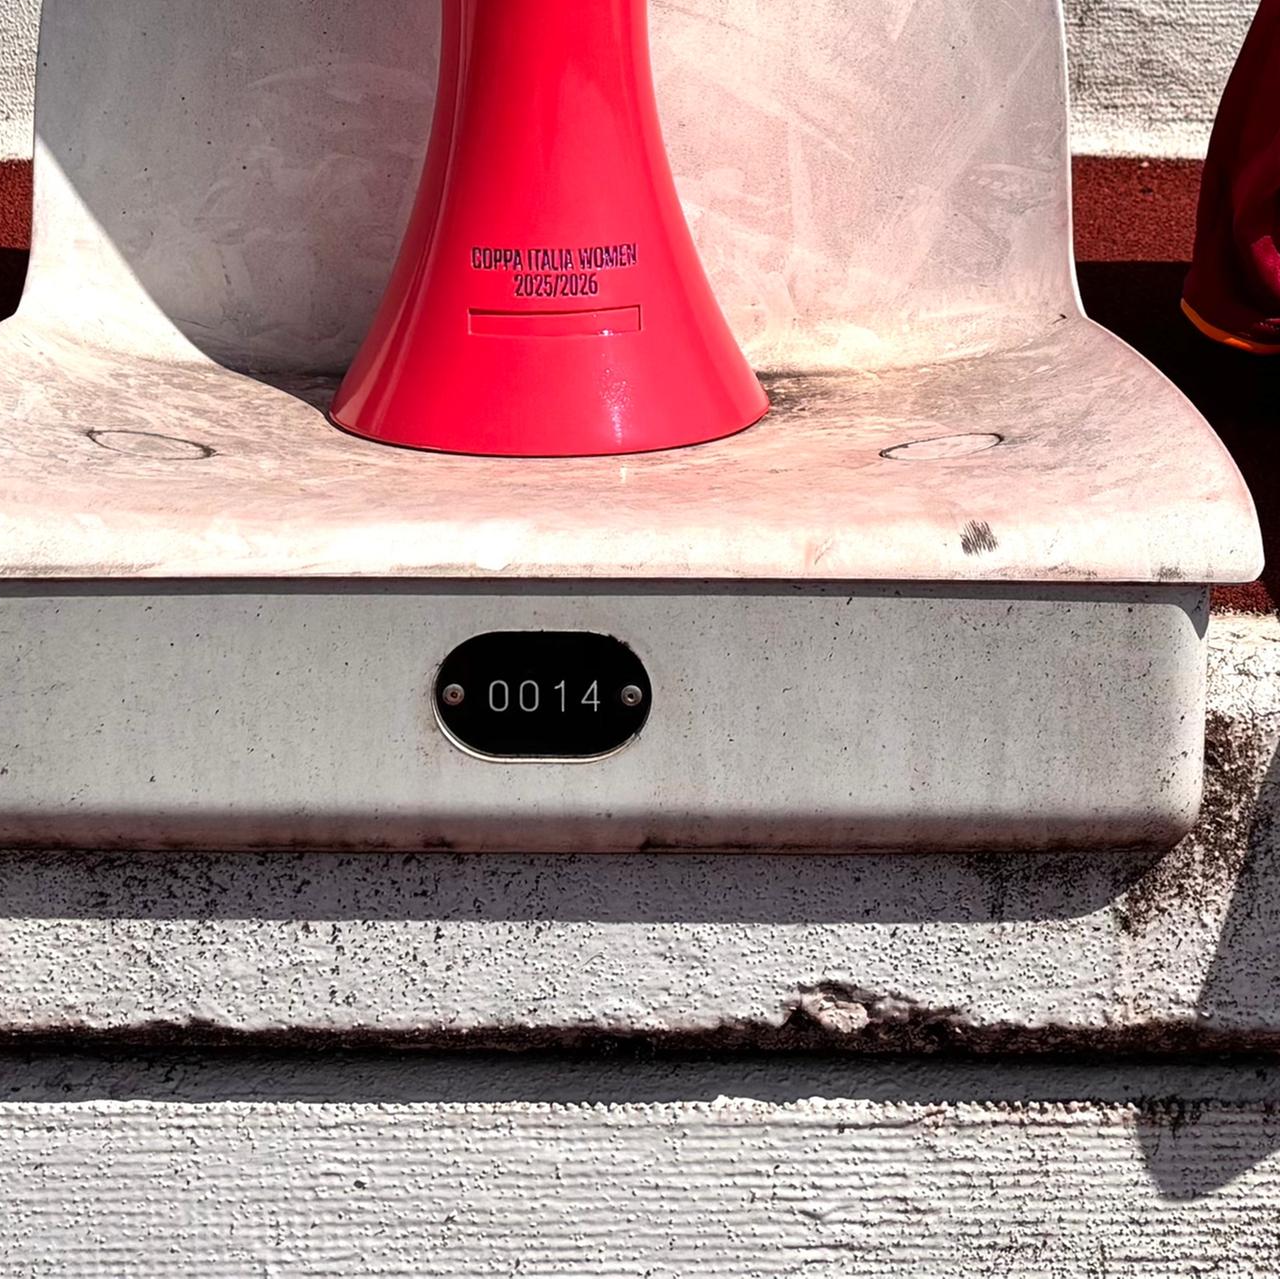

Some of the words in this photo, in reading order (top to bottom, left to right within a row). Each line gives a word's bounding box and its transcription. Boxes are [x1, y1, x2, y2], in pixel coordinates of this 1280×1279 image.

[471, 246, 523, 271] COPPA
[527, 247, 573, 272] ITALIA
[578, 243, 637, 269] WOMEN
[514, 273, 598, 297] 2025/2026
[487, 678, 602, 714] 0014
